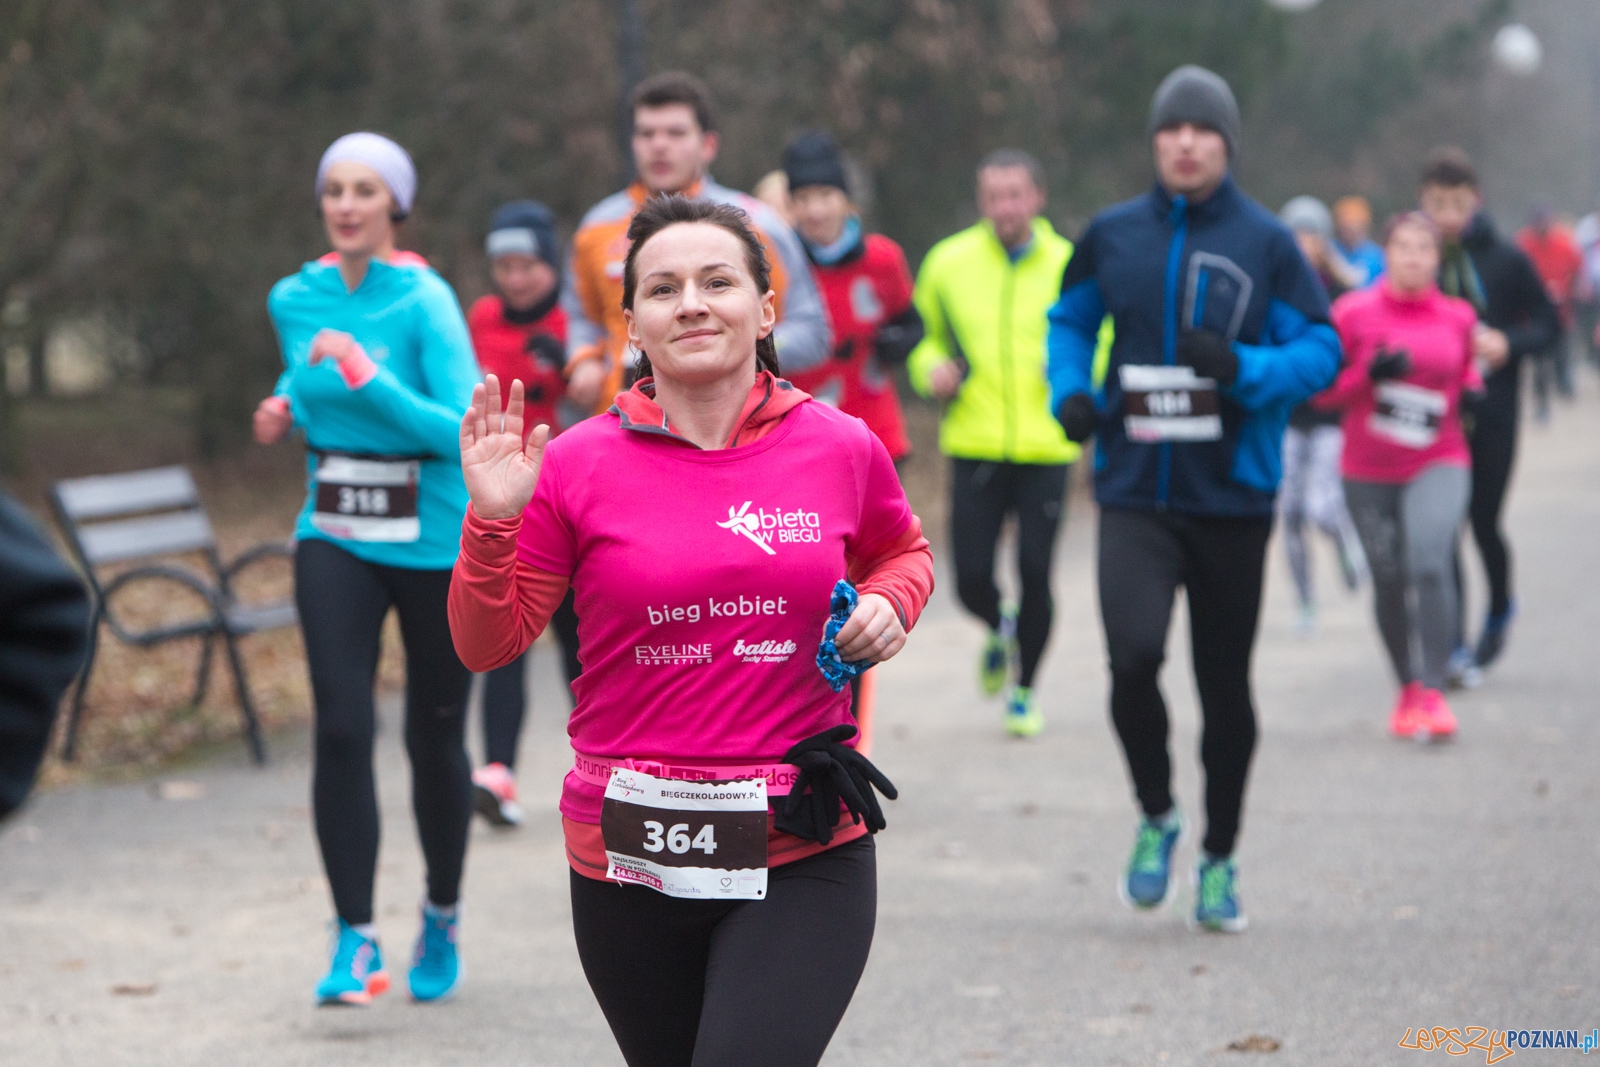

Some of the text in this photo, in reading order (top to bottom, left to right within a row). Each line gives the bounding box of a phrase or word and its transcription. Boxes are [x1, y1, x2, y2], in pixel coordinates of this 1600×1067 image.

[778, 528, 821, 543] BIEGU
[647, 595, 788, 626] bieg kobiet
[635, 643, 712, 659] EVELINE
[733, 639, 797, 656] batiste
[636, 657, 712, 665] COSMETICS
[661, 790, 759, 800] BIEGCZEKOLADOWY.PL
[642, 820, 717, 855] 364
